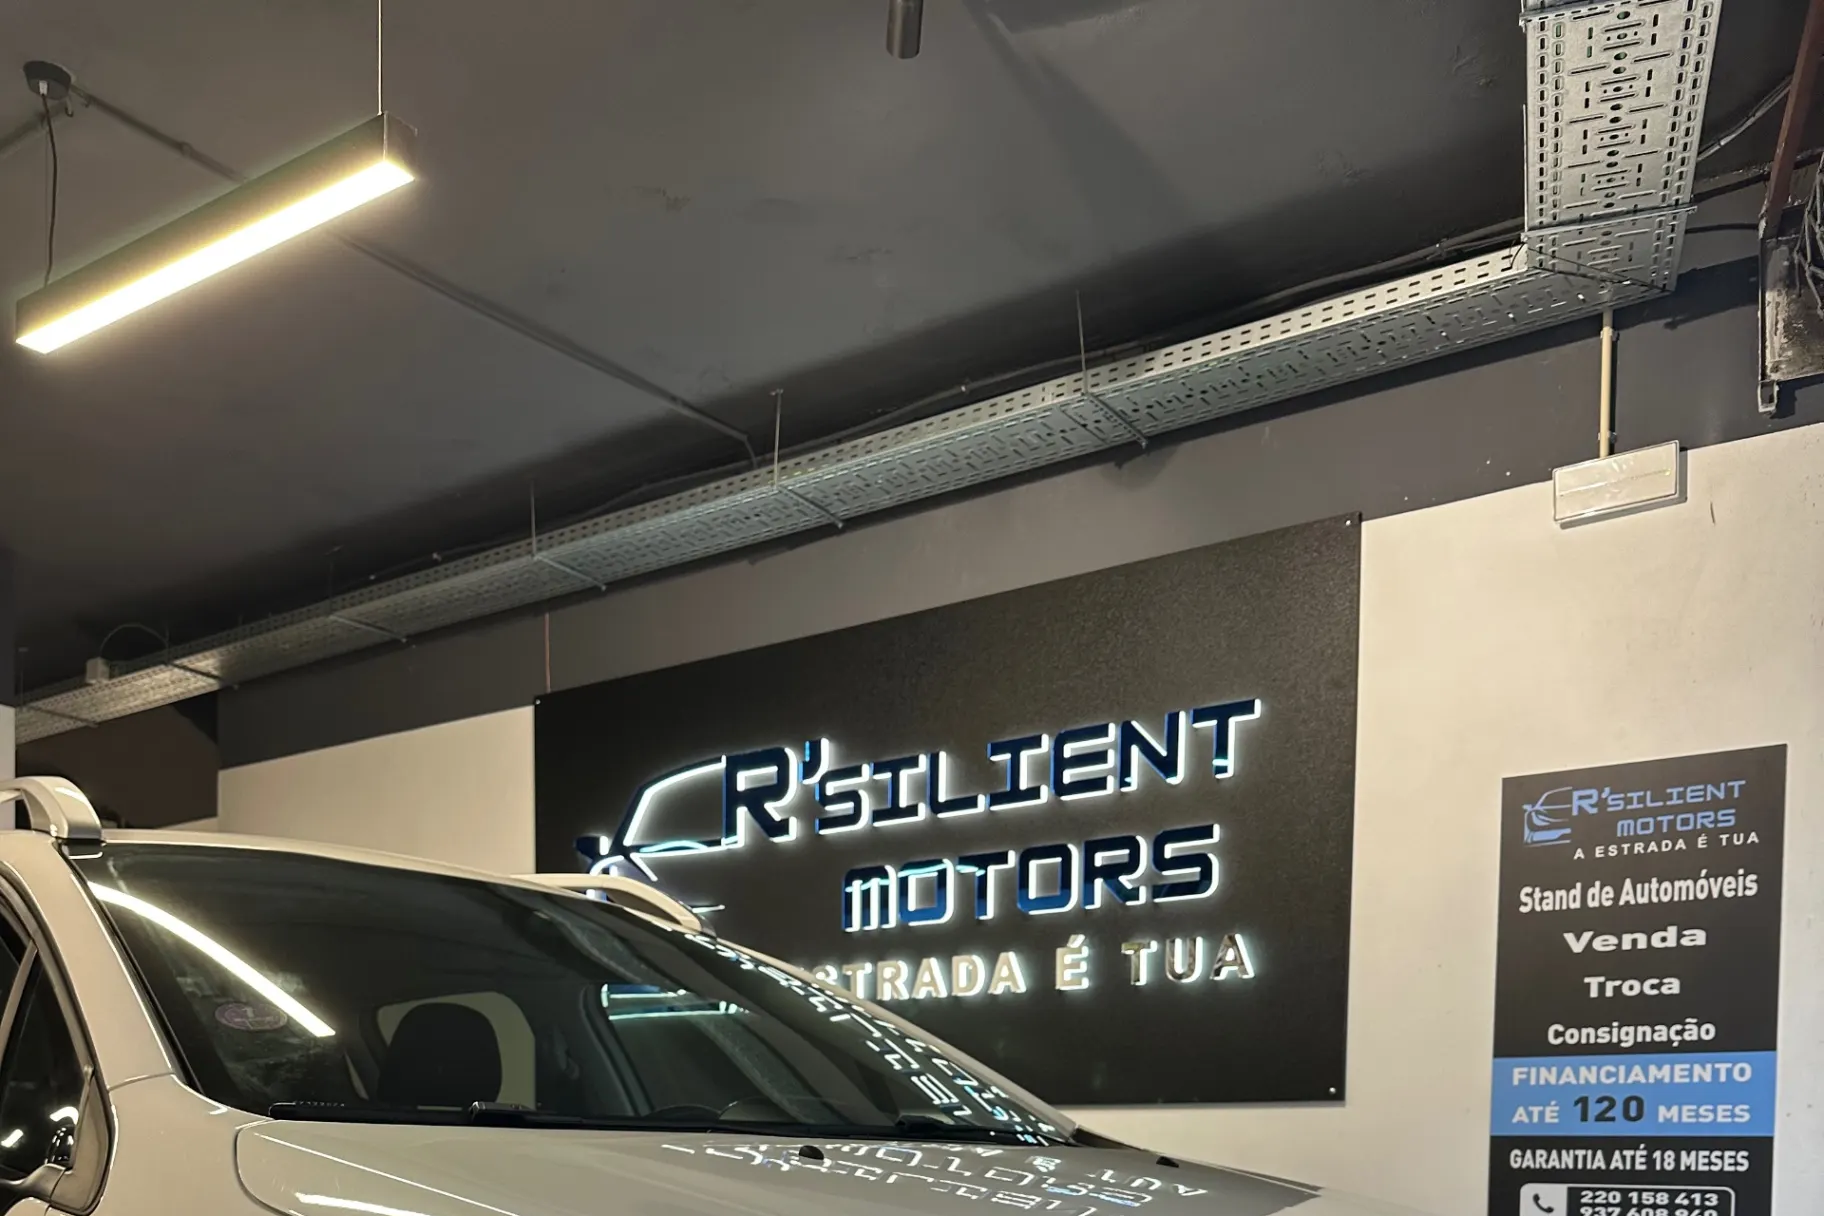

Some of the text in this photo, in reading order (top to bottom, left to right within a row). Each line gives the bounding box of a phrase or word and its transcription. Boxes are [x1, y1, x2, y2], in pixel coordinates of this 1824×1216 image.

[1616, 808, 1736, 837] MOTORS
[1573, 831, 1759, 860] A ESTRADA É TUA
[841, 823, 1219, 932] MOTORS
[1519, 868, 1758, 913] Stand de Automóveis
[1563, 925, 1707, 953] Venda
[1055, 934, 1090, 991] É
[1121, 933, 1255, 986] TUA
[1584, 976, 1681, 998] Troca
[1547, 1018, 1716, 1048] Consignação
[1512, 1062, 1752, 1086] FINANCIAMENTO
[1512, 1095, 1751, 1124] ATÉ 120 MESES
[1509, 1144, 1749, 1171] GARANTIA ATÉ 18 MESES
[1580, 1190, 1719, 1206] 220 158 413
